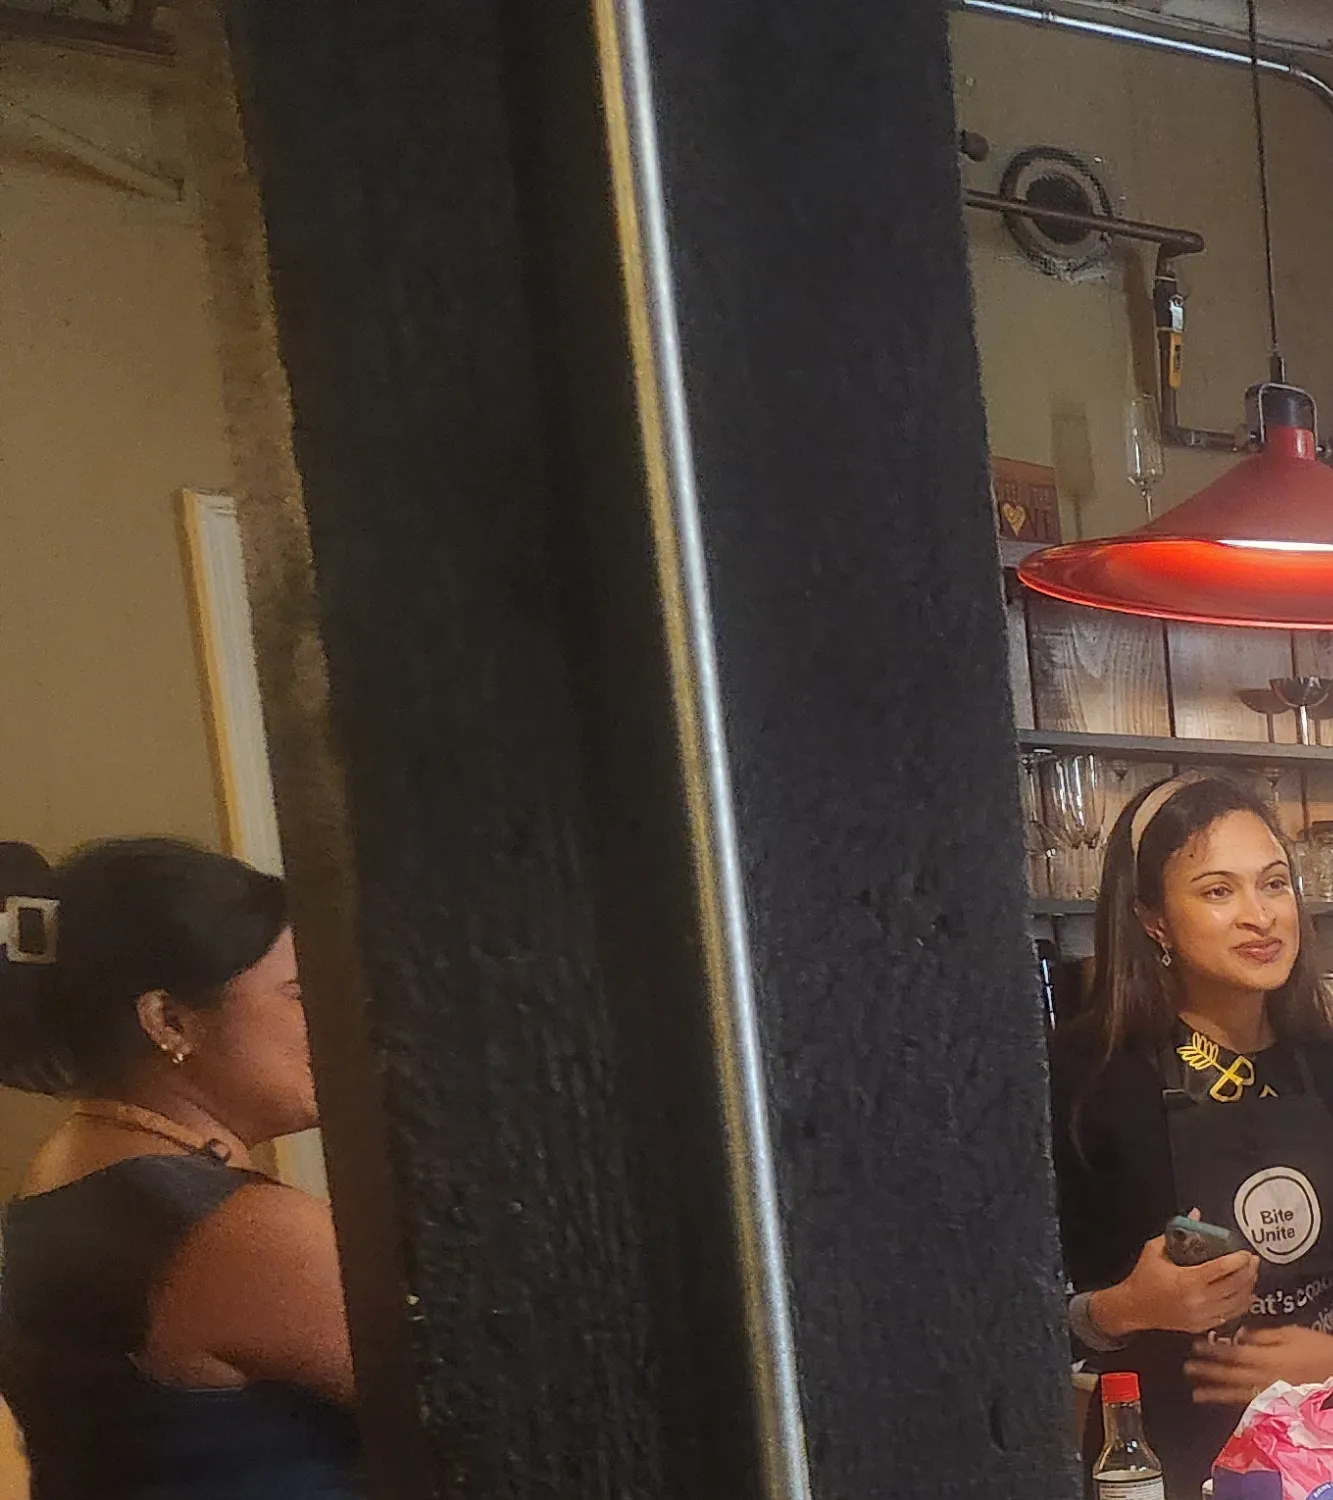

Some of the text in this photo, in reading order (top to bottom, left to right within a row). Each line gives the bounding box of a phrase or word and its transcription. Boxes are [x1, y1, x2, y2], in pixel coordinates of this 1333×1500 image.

[1260, 1208, 1294, 1225] Bite
[1251, 1226, 1296, 1245] Unite
[1249, 1290, 1296, 1315] at's
